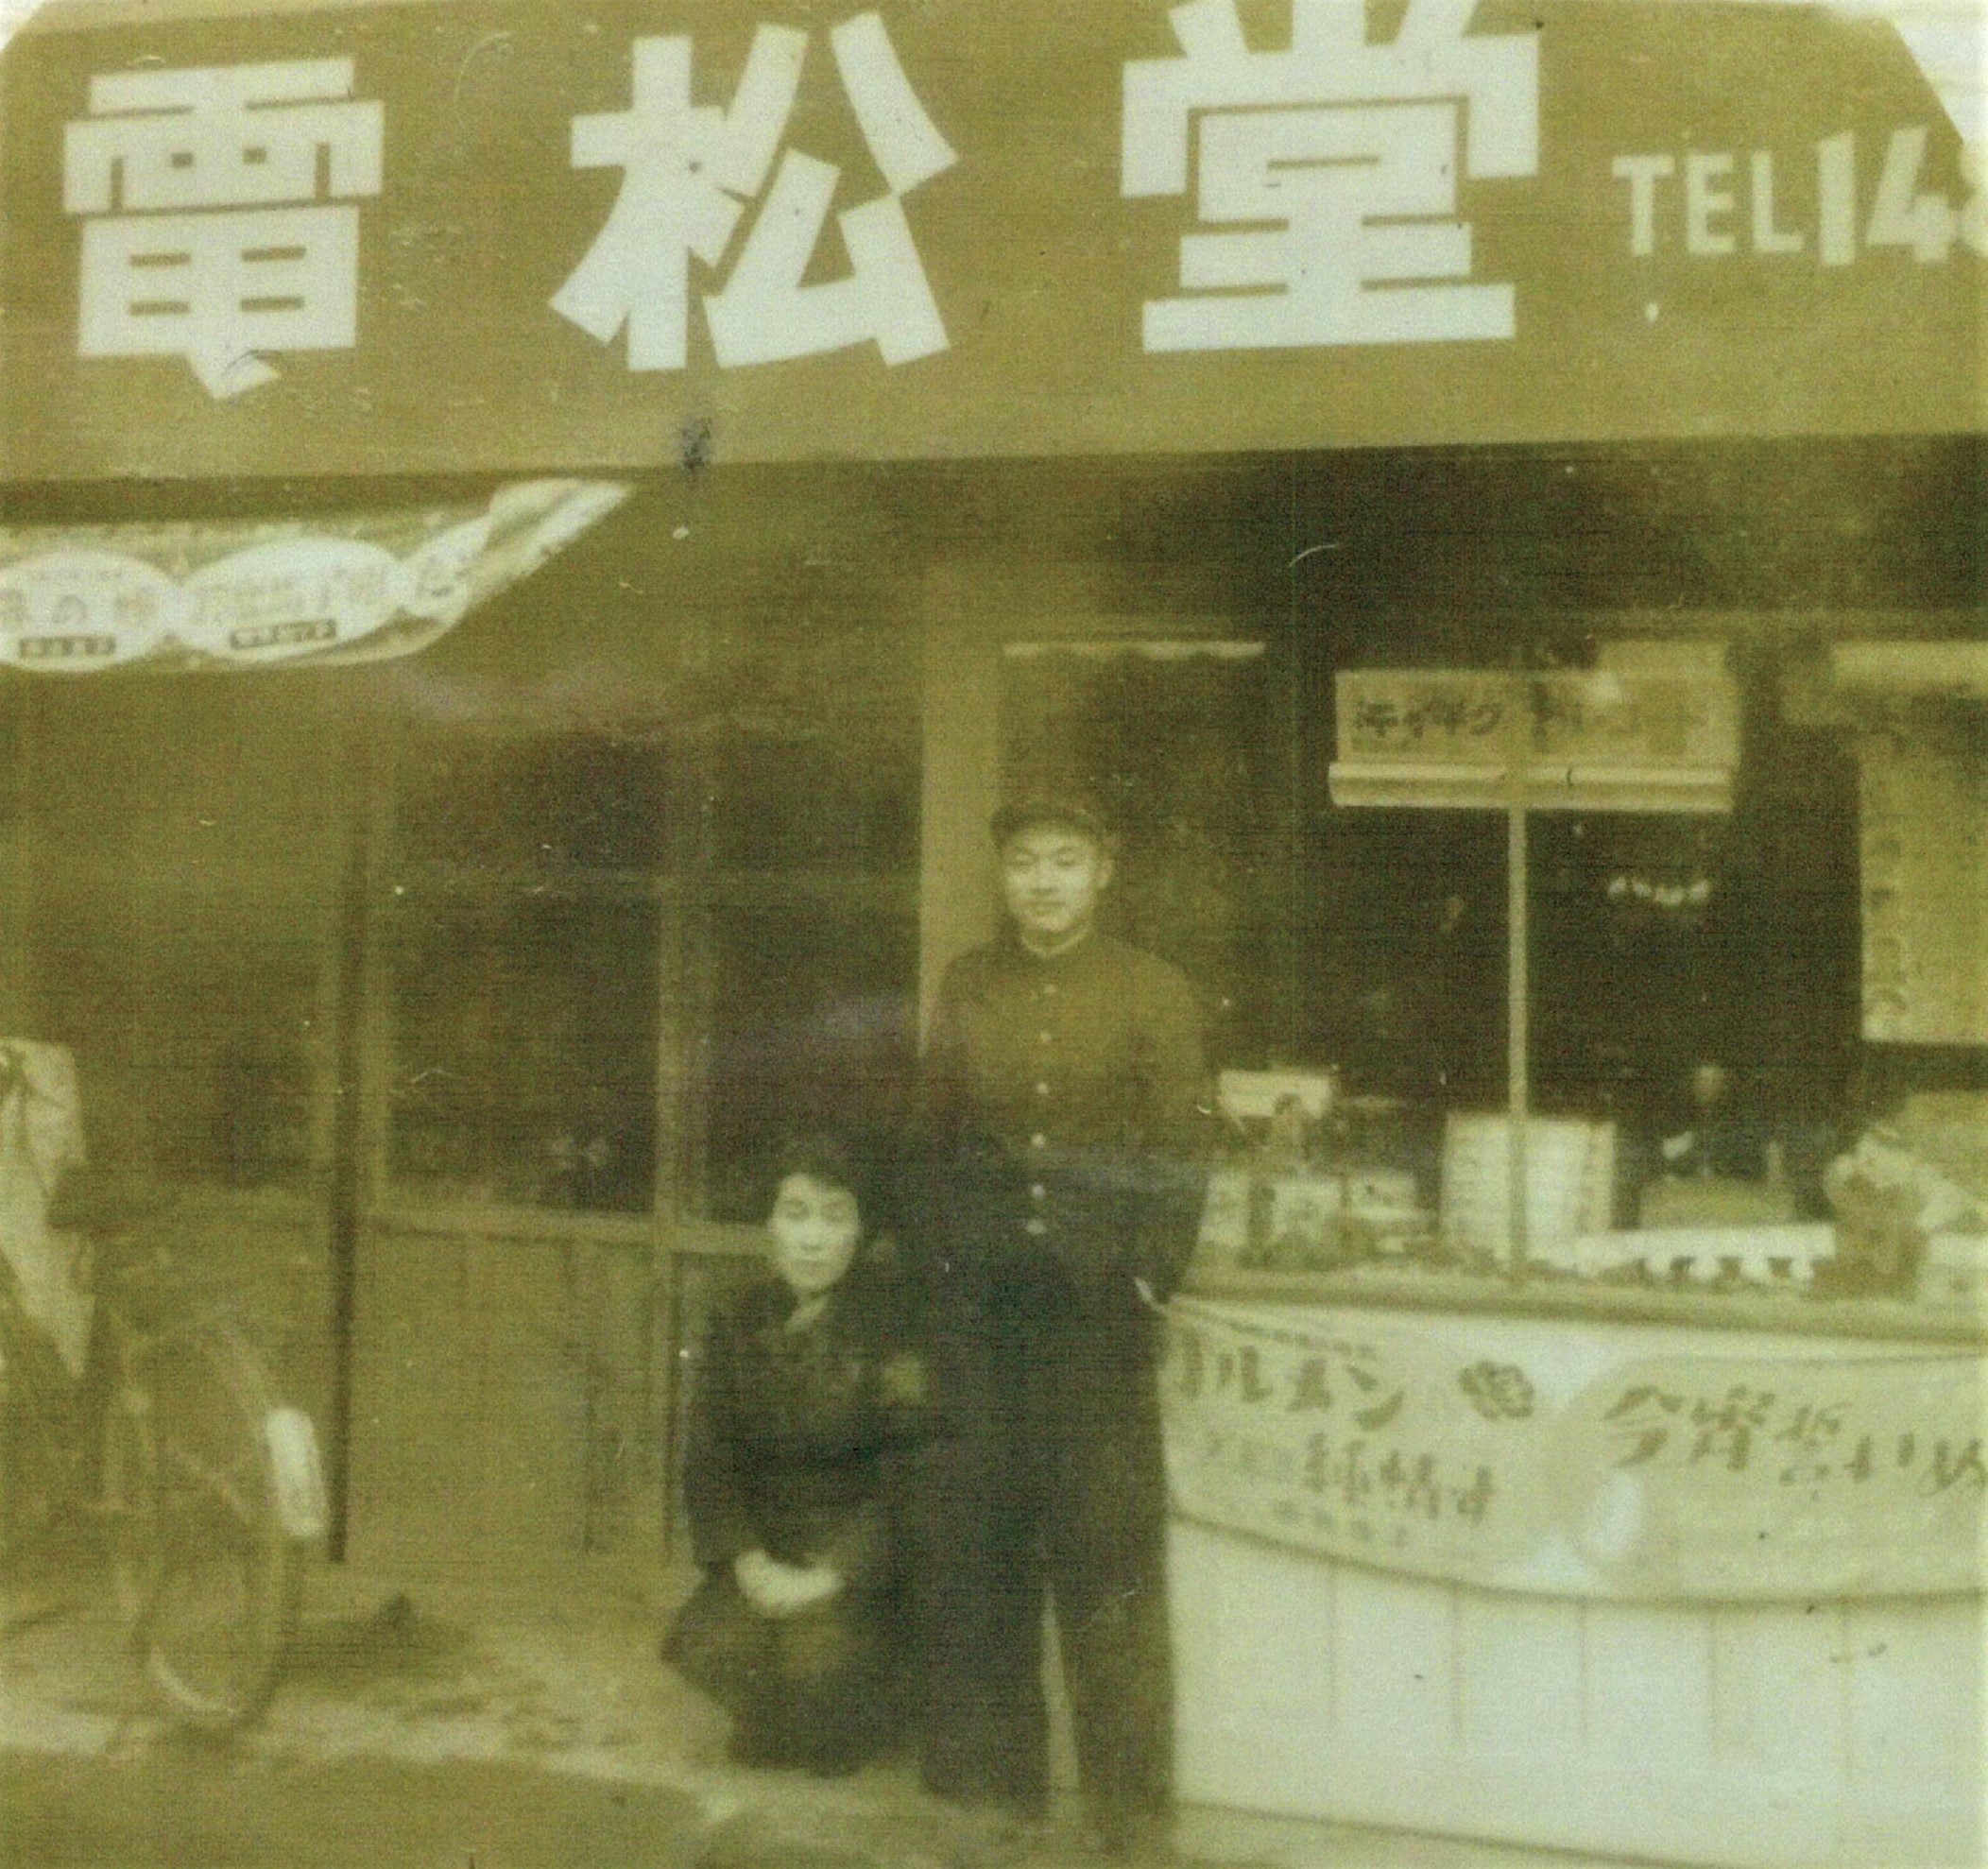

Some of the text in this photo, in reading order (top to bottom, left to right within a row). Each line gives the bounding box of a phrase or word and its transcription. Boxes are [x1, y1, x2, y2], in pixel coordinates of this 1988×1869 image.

[62, 0, 1541, 400] 電松堂
[1611, 148, 1806, 258] TEL
